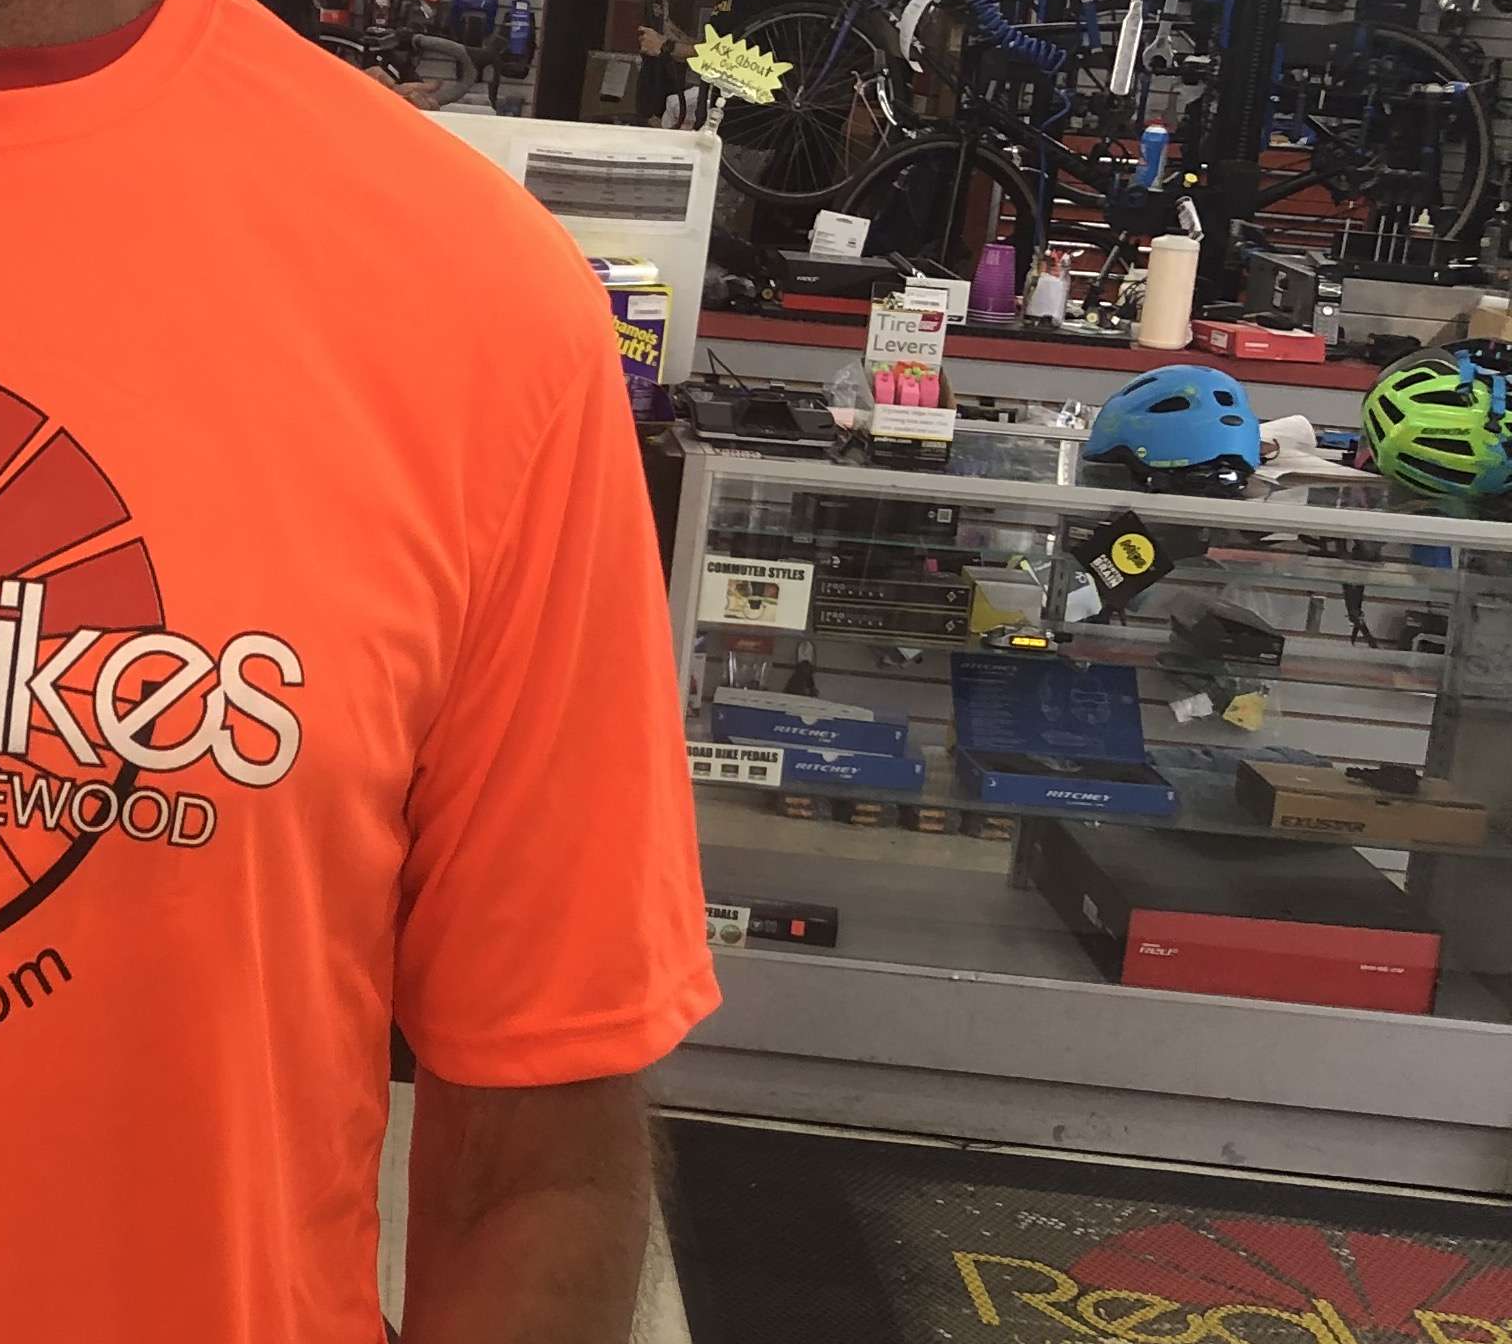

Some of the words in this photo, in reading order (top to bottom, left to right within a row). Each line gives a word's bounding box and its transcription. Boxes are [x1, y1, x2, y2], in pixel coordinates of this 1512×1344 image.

[613, 315, 658, 344] hamois
[877, 313, 917, 333] Tire
[617, 337, 659, 365] utt'r
[873, 334, 938, 356] Levers
[707, 560, 766, 578] COMMUTER
[769, 564, 805, 581] STYLES
[773, 724, 840, 738] RITCHEY
[715, 747, 738, 760] BIKE
[741, 750, 778, 763] PEDALS
[794, 762, 862, 774] RITCHEY
[1045, 789, 1112, 802] RITCHEY
